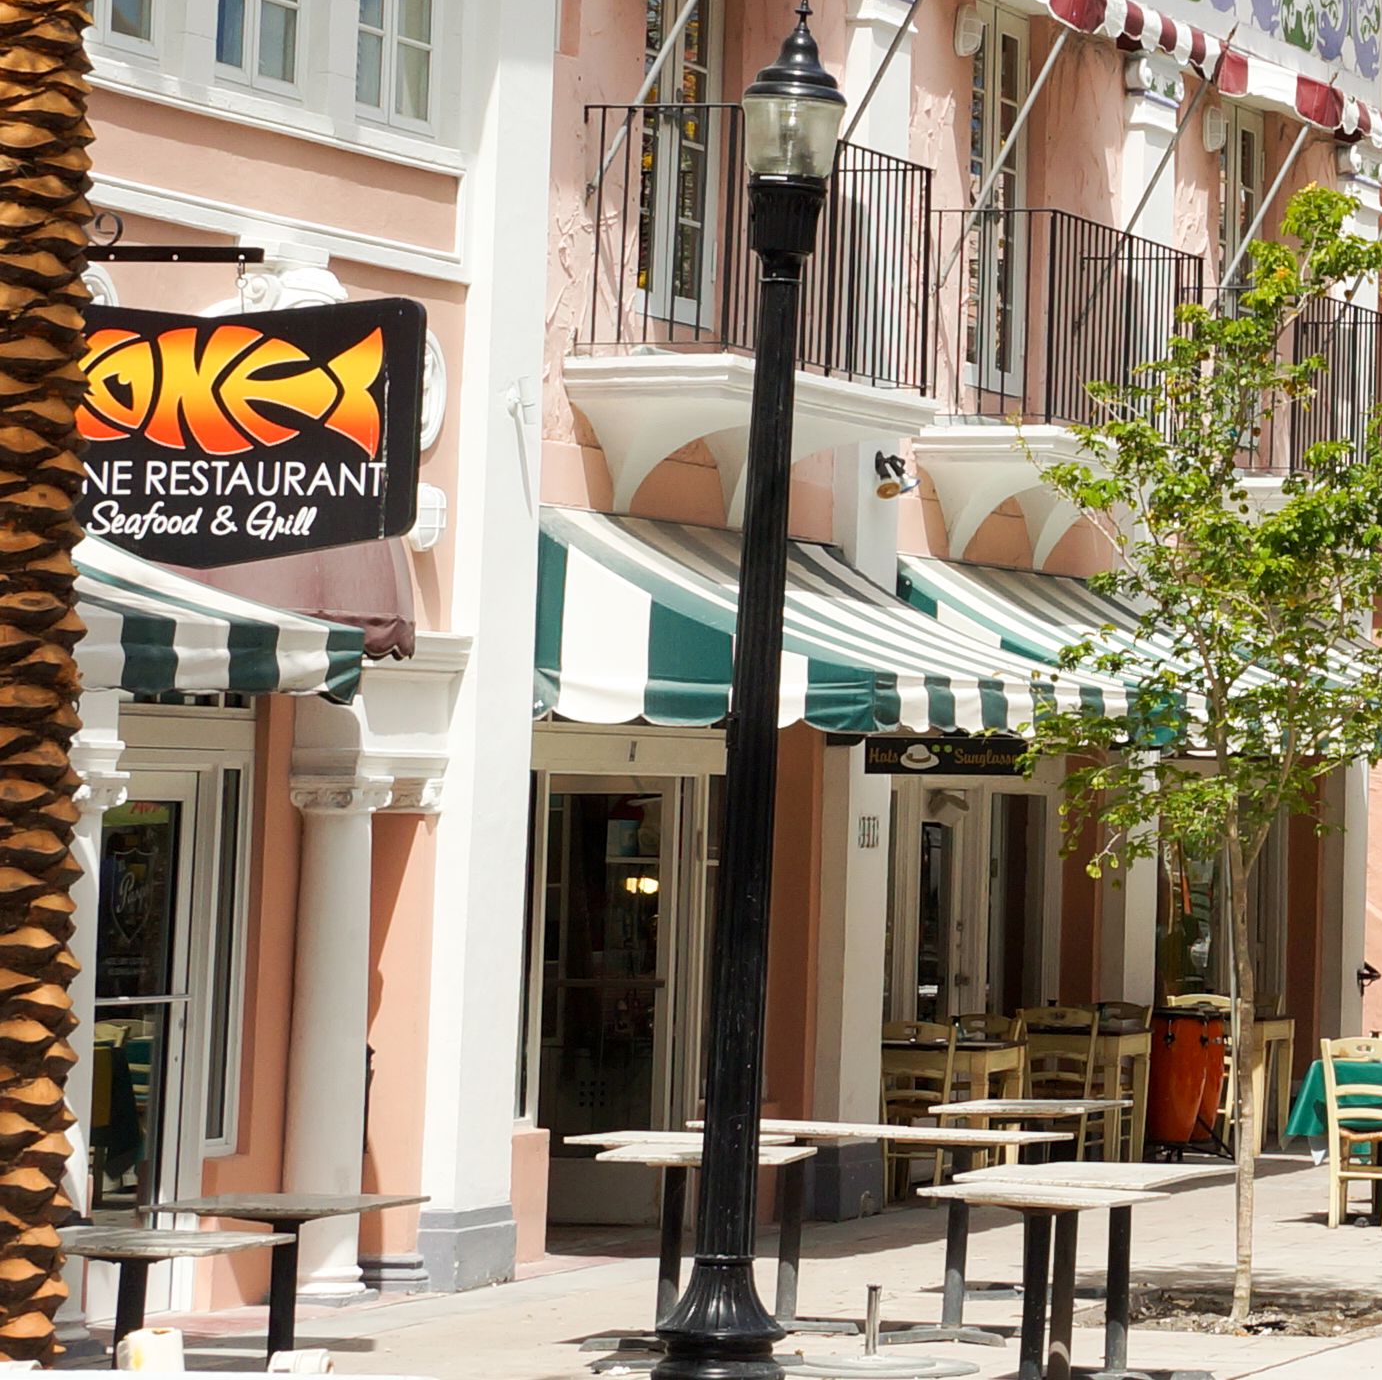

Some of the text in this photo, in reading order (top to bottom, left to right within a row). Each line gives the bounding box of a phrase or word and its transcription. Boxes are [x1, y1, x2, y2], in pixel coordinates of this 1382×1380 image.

[145, 461, 387, 497] RESTAURANT
[87, 500, 318, 541] Seafood & Grill
[868, 747, 898, 764] Hats
